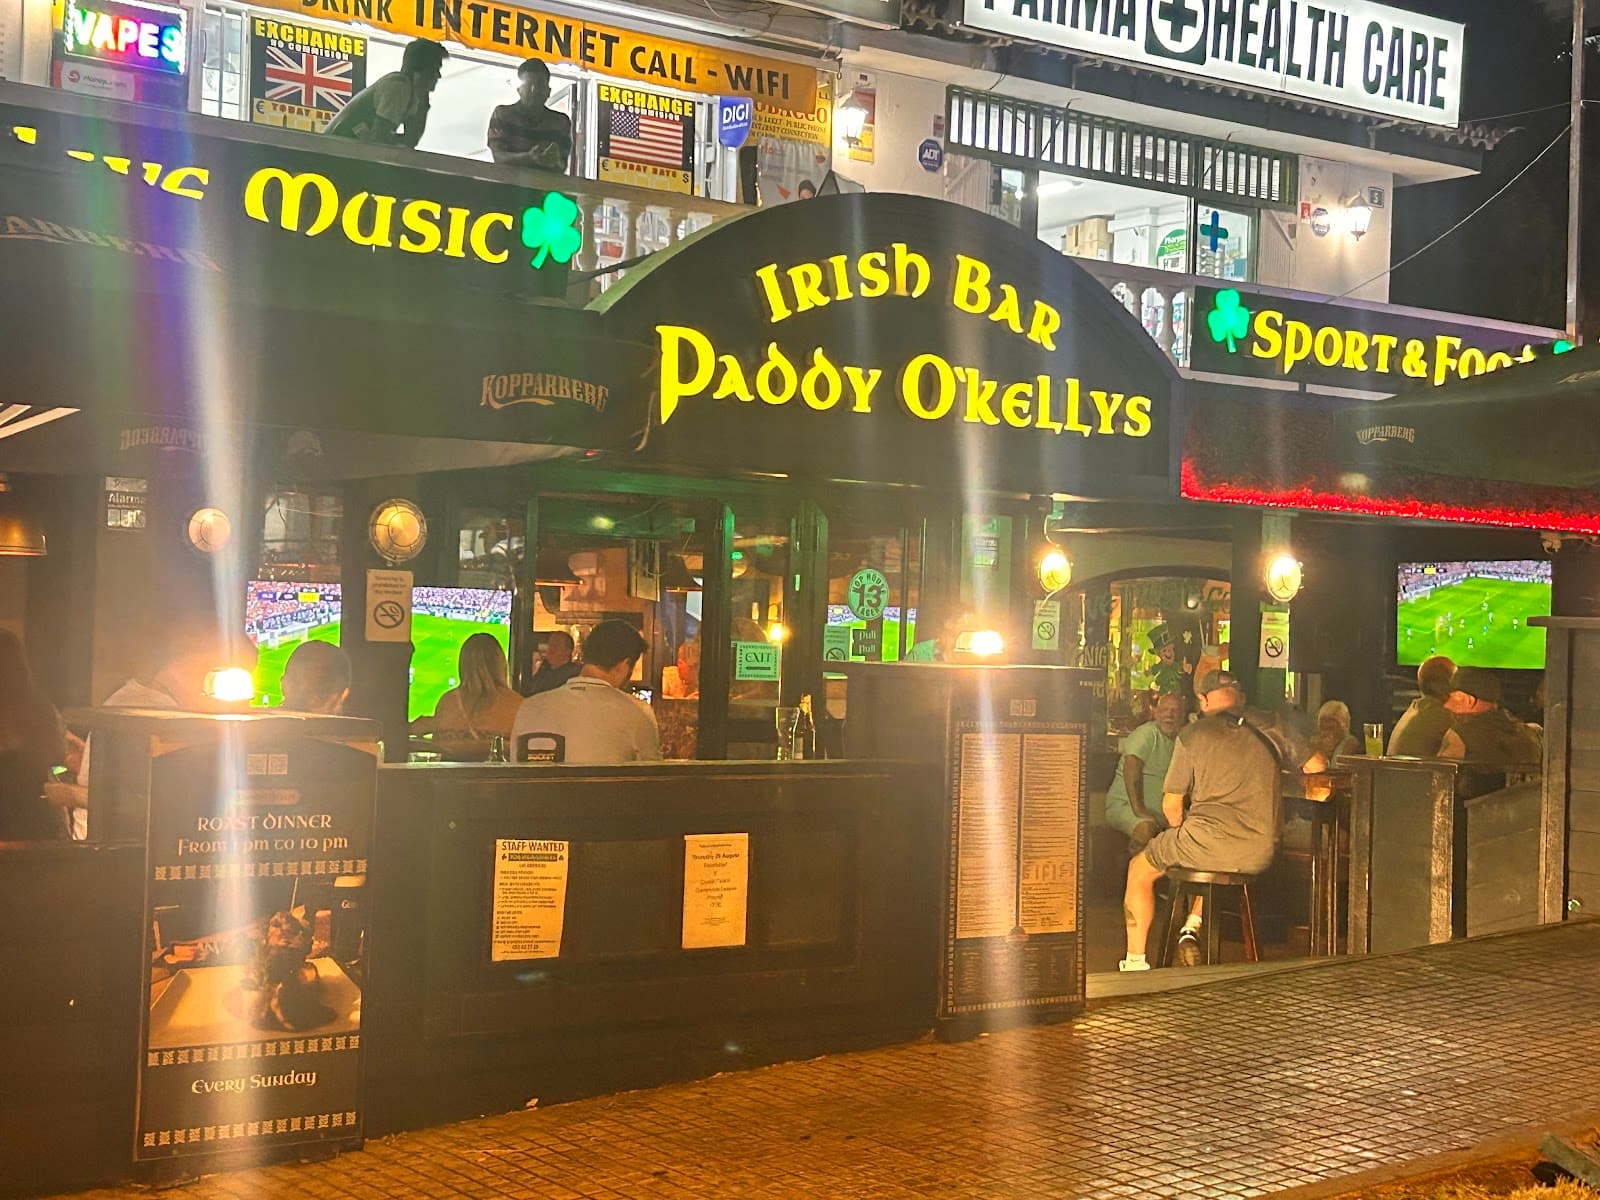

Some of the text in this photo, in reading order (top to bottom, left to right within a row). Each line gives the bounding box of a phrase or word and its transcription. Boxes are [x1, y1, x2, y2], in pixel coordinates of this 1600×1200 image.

[70, 6, 182, 61] VAPES
[255, 18, 366, 58] EXCHANGE
[415, 0, 620, 67] INTERNET
[630, 46, 697, 84] CALL
[724, 63, 789, 100] WIFI
[1212, 0, 1348, 88] HEALTH
[1362, 21, 1450, 110] CARE
[600, 85, 693, 117] EXCHANGE
[722, 102, 749, 125] DIGI
[243, 167, 513, 263] MUSIC
[1402, 339, 1428, 378] &
[856, 583, 882, 608] 13
[501, 841, 565, 852] STAFF WANTED
